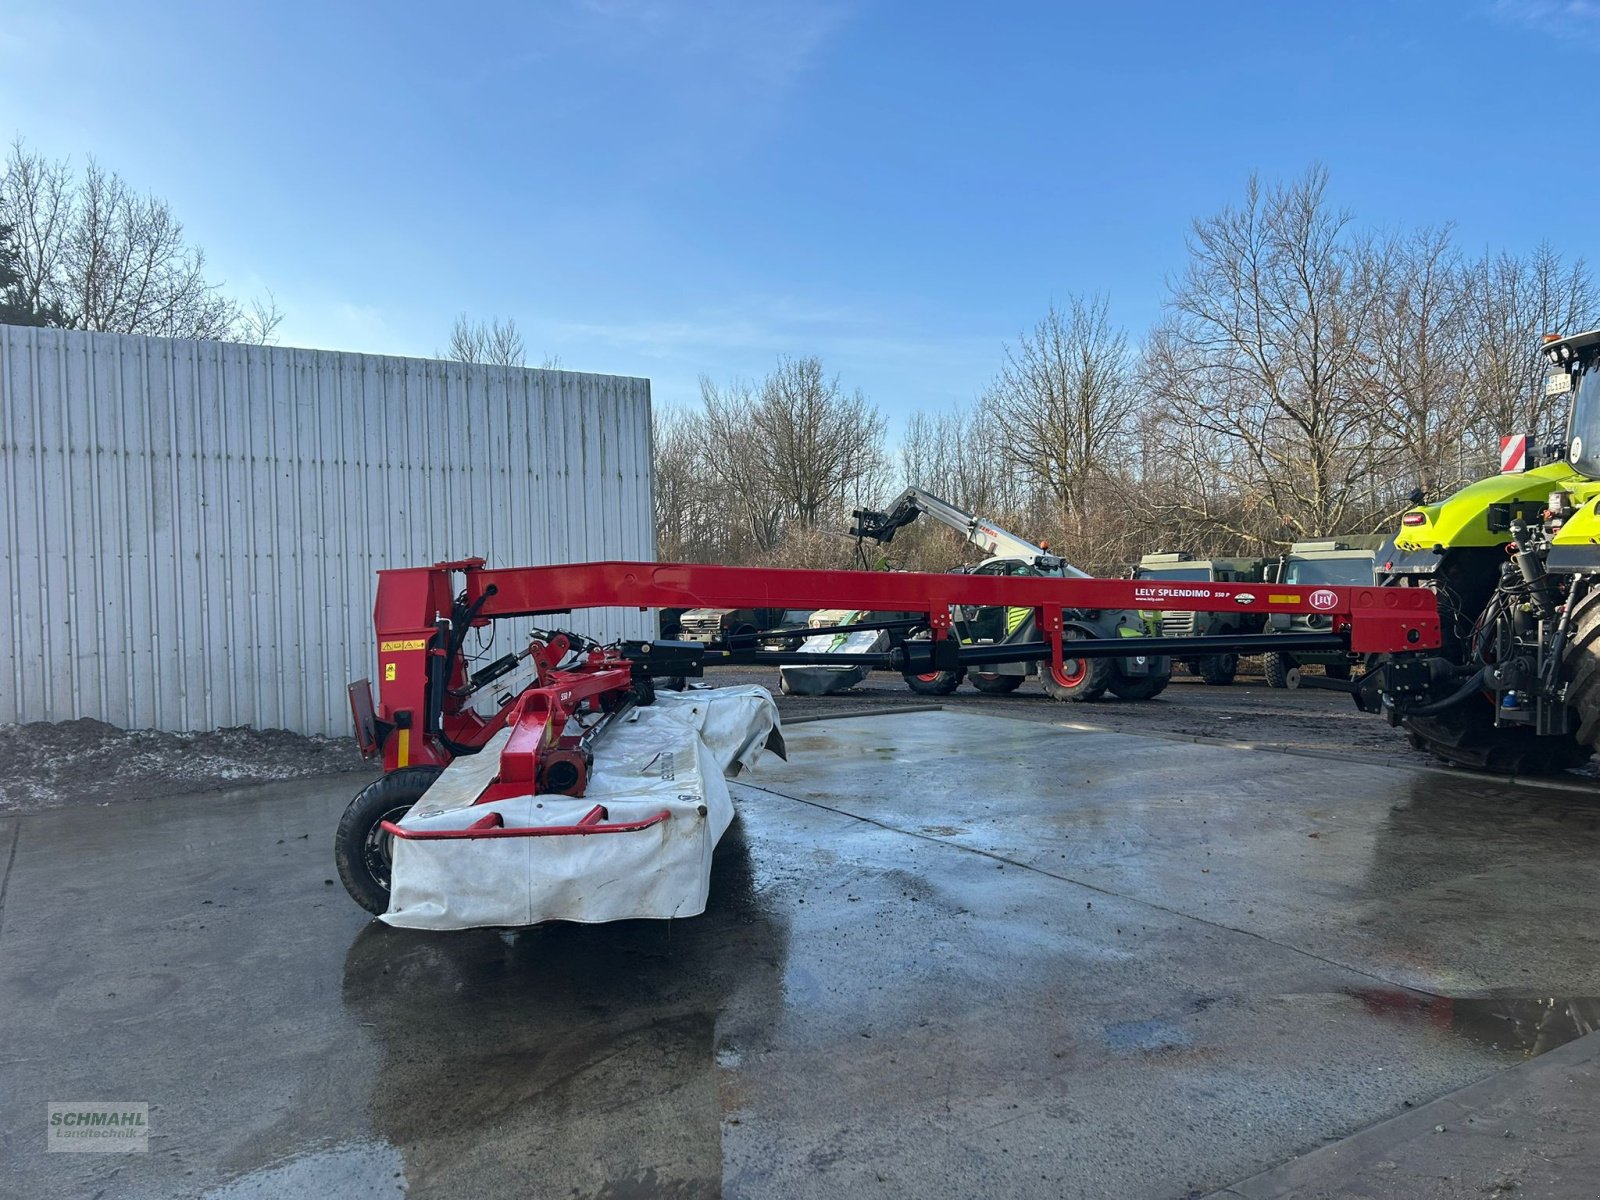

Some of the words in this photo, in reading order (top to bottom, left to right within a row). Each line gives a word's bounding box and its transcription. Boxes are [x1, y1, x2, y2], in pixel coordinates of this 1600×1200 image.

[1135, 588, 1156, 596] LELY
[1158, 588, 1211, 598] SPLENDIMO
[1314, 591, 1333, 606] LELY
